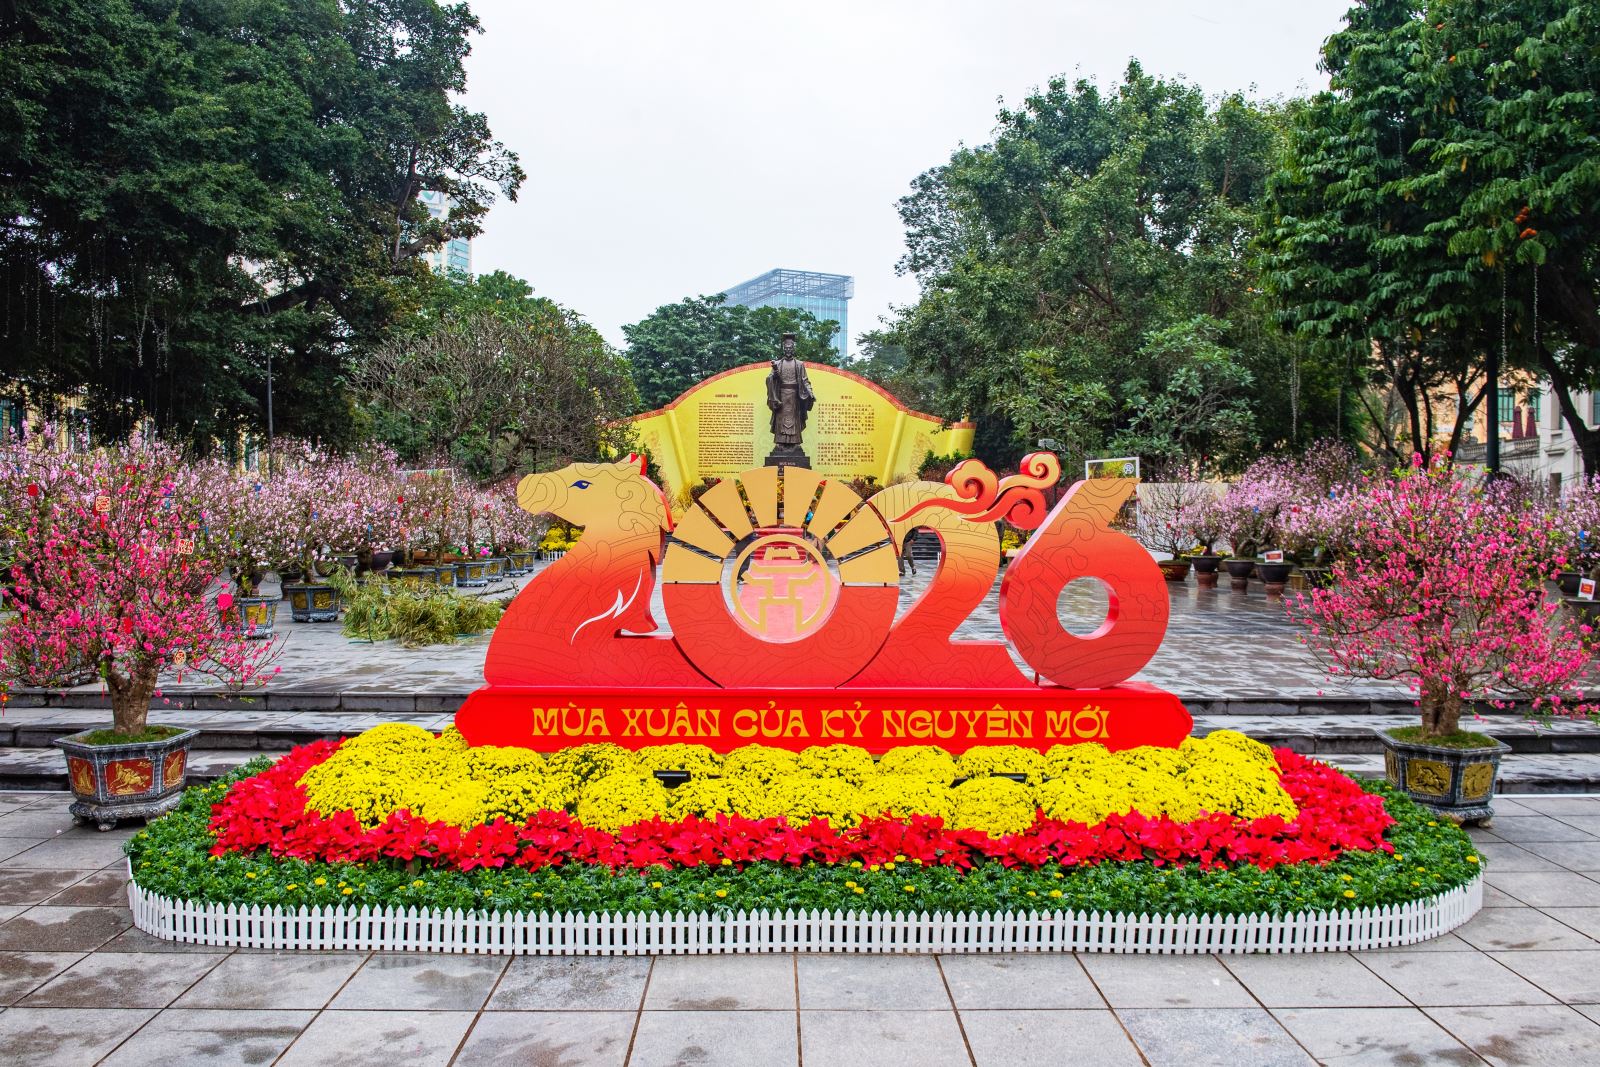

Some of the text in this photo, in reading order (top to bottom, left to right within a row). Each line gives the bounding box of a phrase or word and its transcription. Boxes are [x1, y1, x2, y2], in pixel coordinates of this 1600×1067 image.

[484, 456, 1169, 688] 2026
[532, 700, 1110, 738] MÙA XUÂN CỦA KỶ NGUYÊN MỚI
